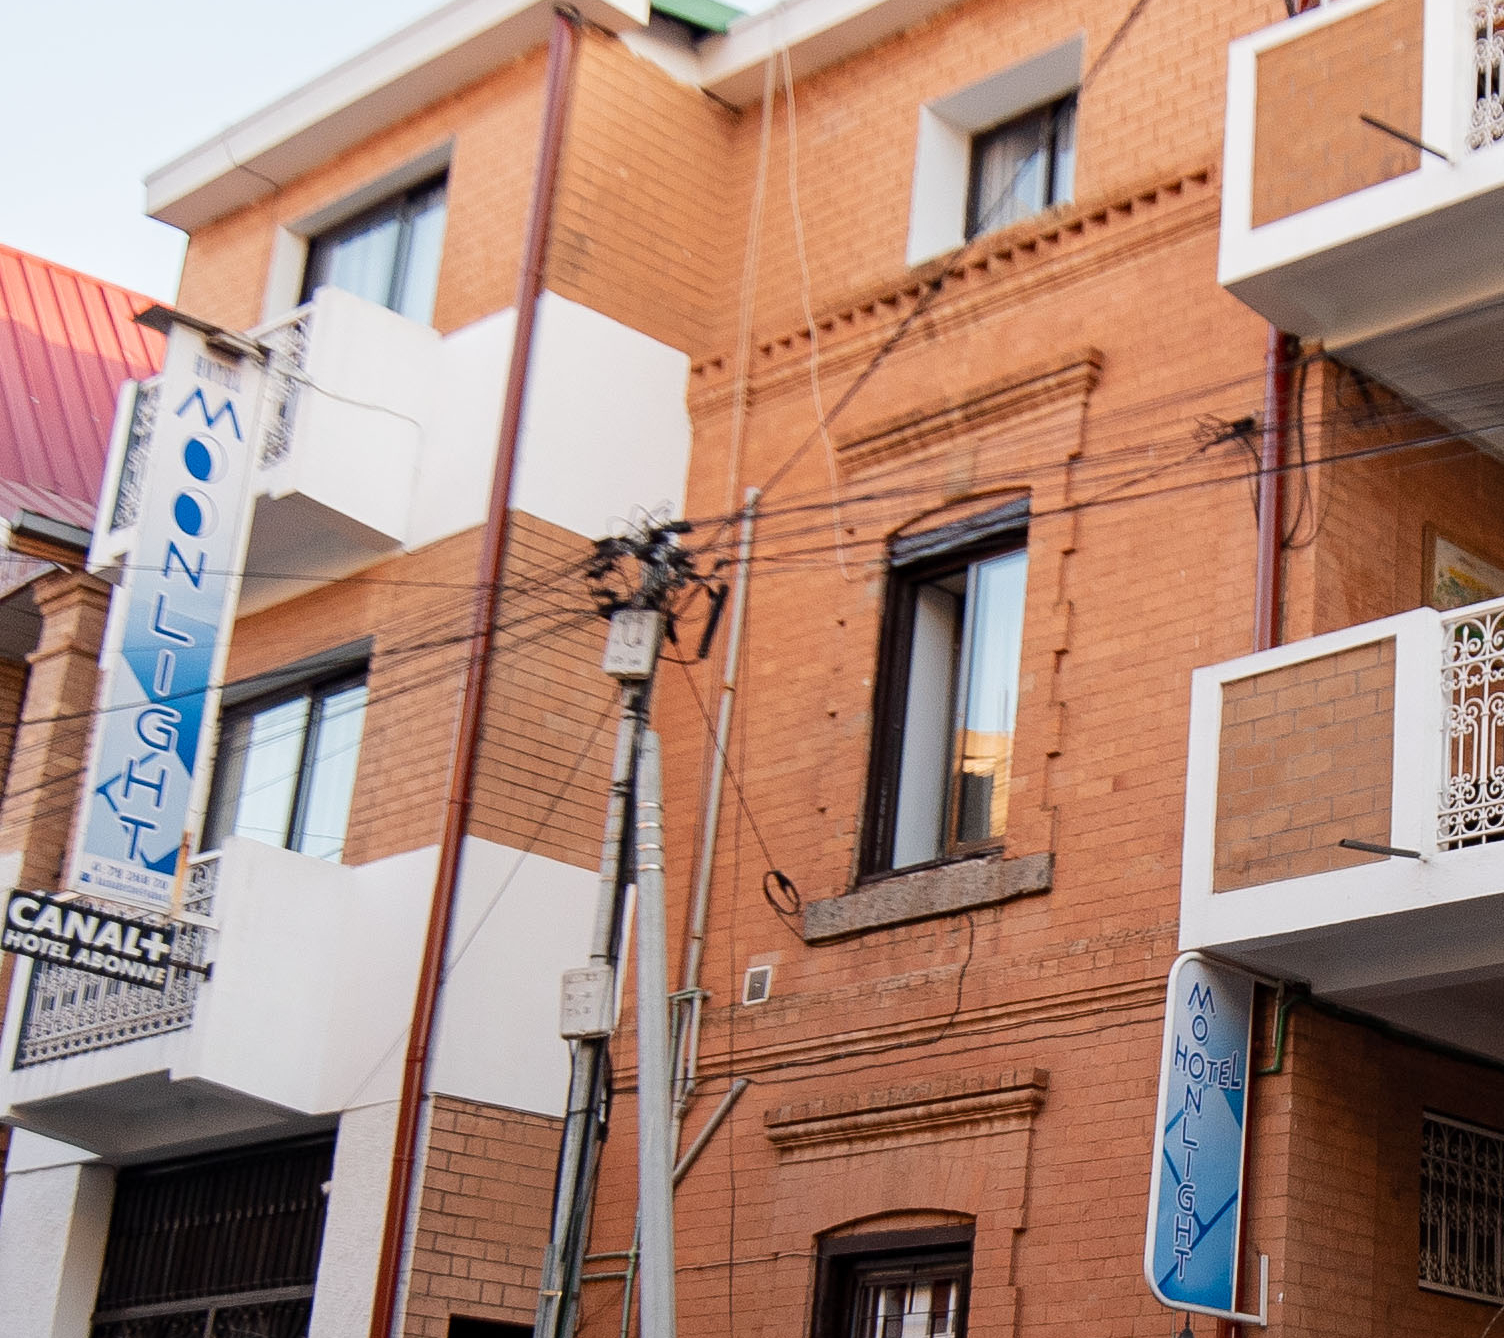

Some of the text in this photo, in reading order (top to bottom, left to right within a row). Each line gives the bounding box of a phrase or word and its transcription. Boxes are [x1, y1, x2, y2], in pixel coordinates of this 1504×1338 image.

[119, 387, 243, 862] MOONLIGHT
[3, 928, 72, 961] HOTEL
[8, 896, 172, 961] CANAL+
[1174, 1034, 1242, 1089] HOTEL
[1173, 982, 1216, 1280] MOONLIGHT
